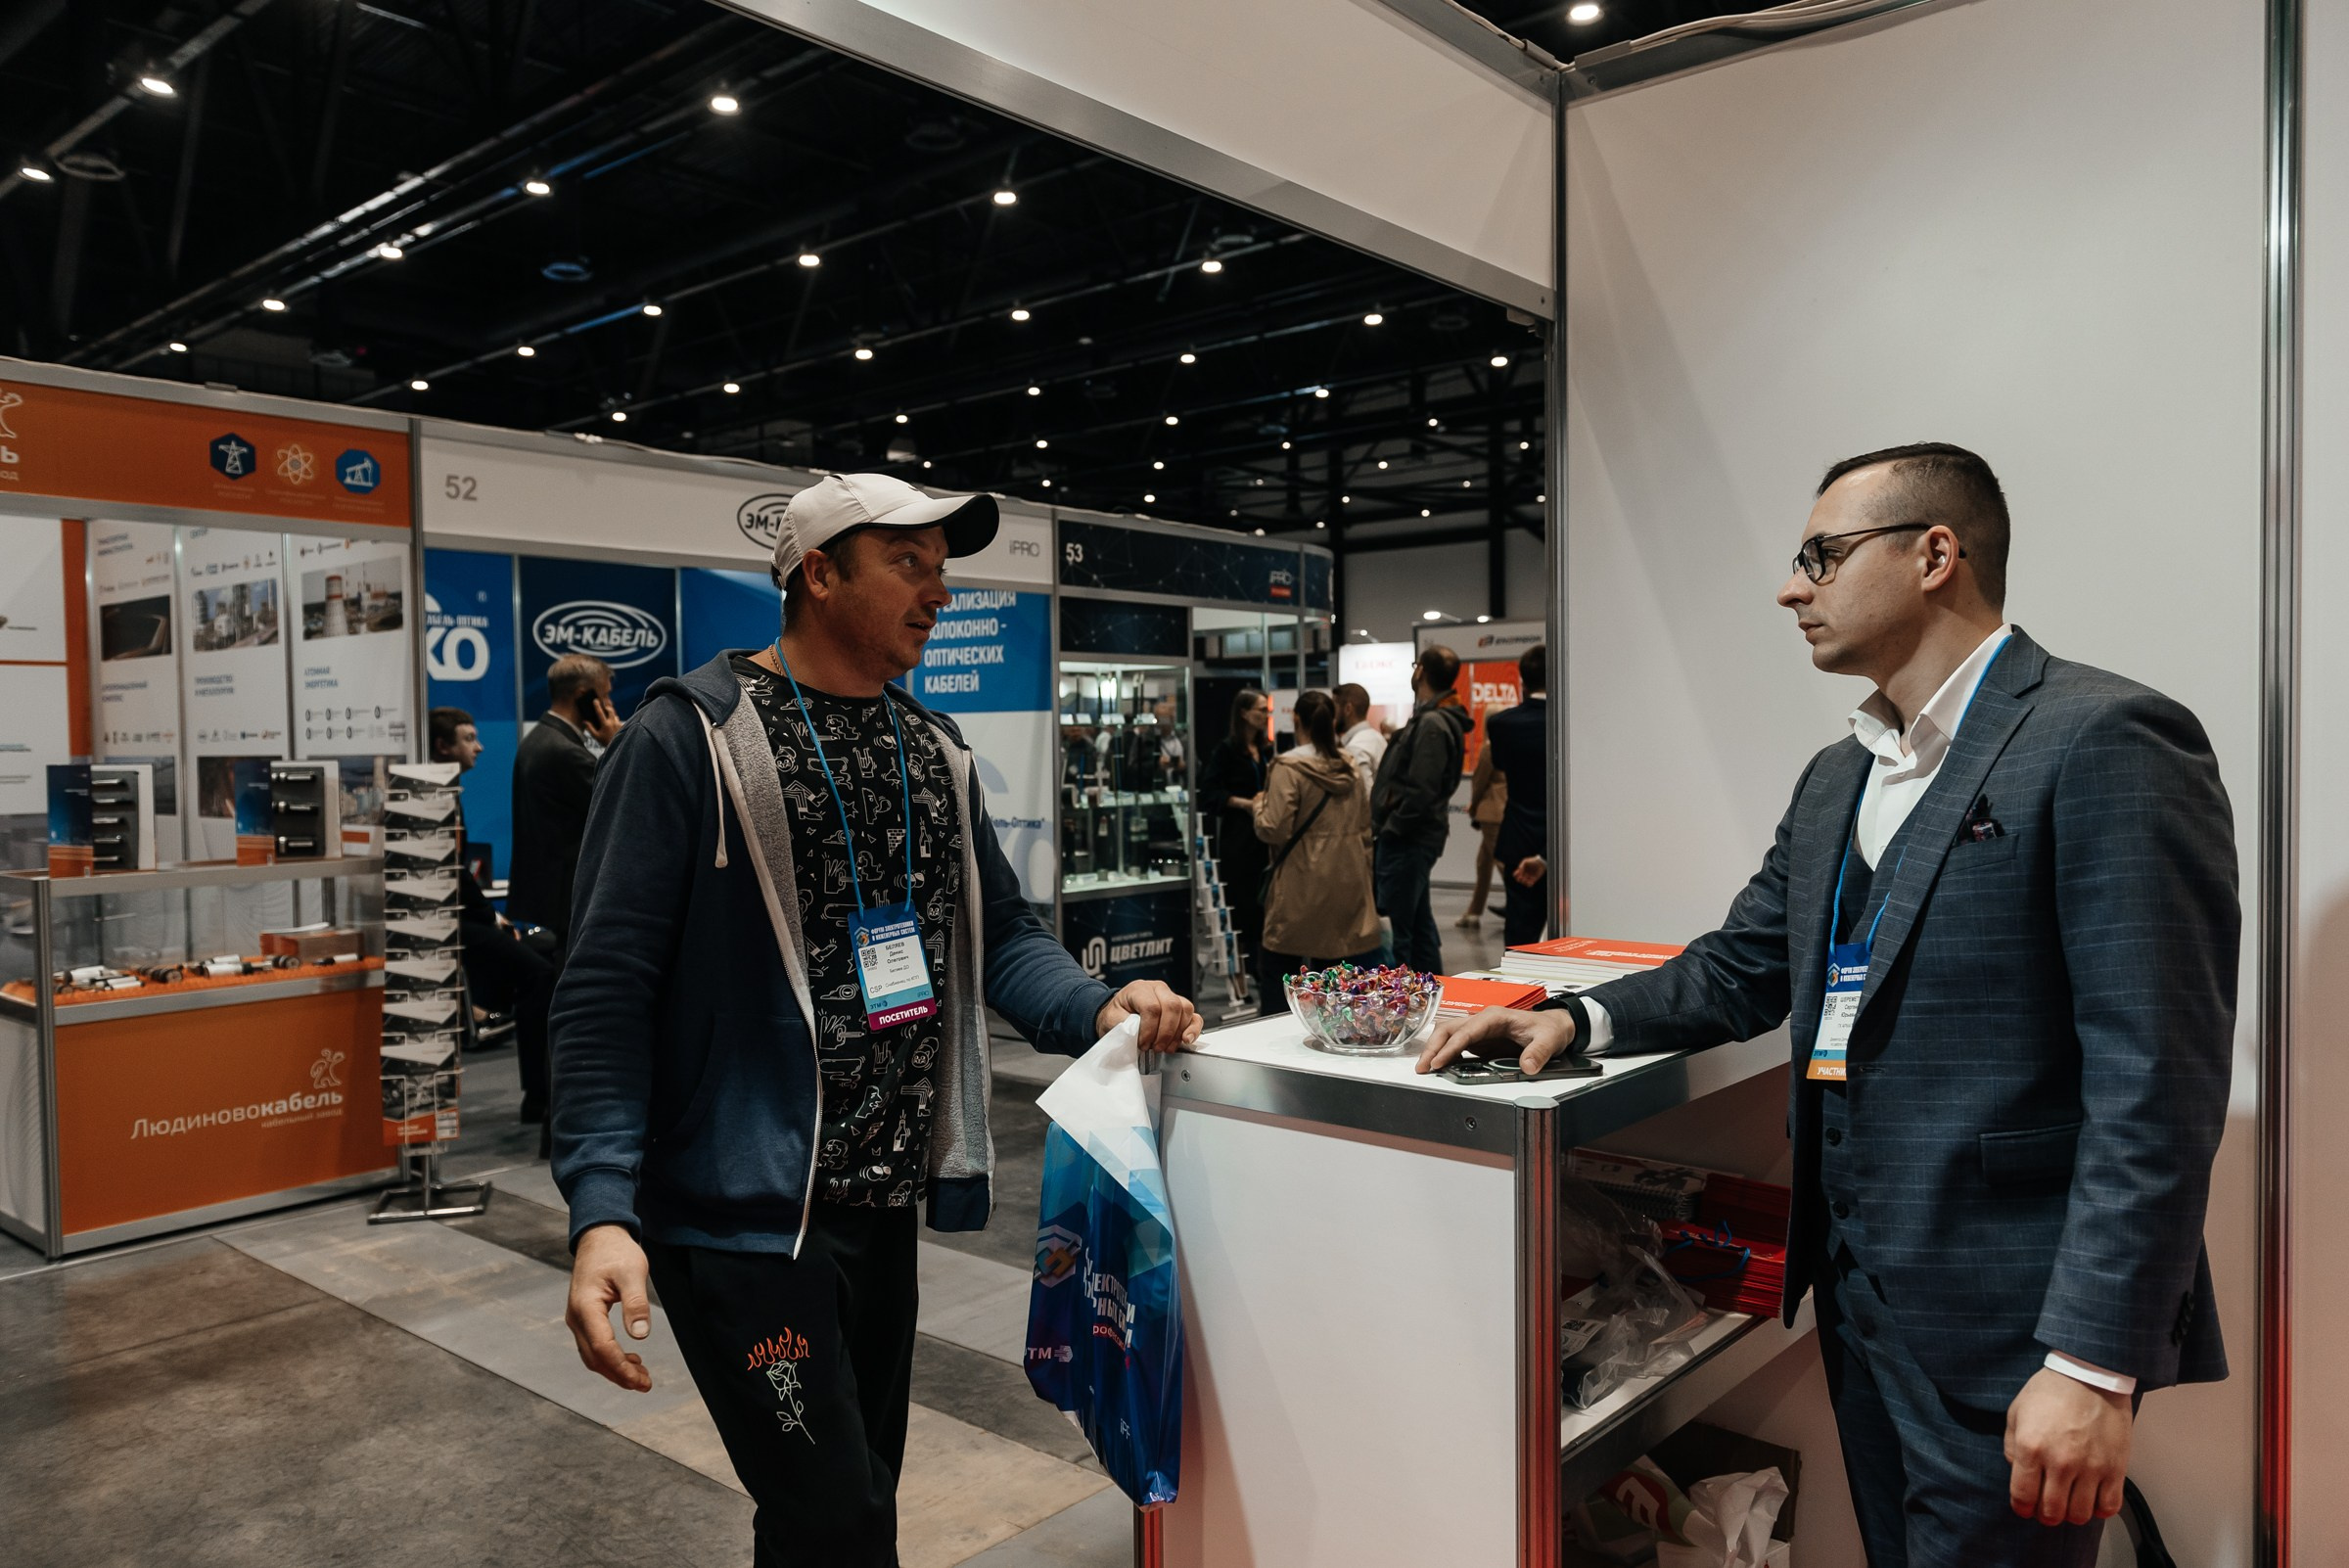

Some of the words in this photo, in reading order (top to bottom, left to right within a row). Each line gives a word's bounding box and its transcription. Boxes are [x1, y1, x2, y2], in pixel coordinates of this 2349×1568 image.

[445, 474, 477, 501] 52
[1066, 542, 1083, 564] 53
[542, 623, 659, 648] ЭМ-КАБЕЛЬ
[930, 618, 999, 641] ОЛОКОННО
[924, 645, 1004, 668] ОПТИЧЕСКИХ
[924, 669, 980, 694] КАБЕЛЕЙ
[1472, 682, 1518, 704] DELTA
[1111, 938, 1174, 964] ЦВЕТЛИТ
[879, 1006, 928, 1025] ПОСЕТИТЕЛЬ
[130, 1090, 345, 1139] Людиновокабель
